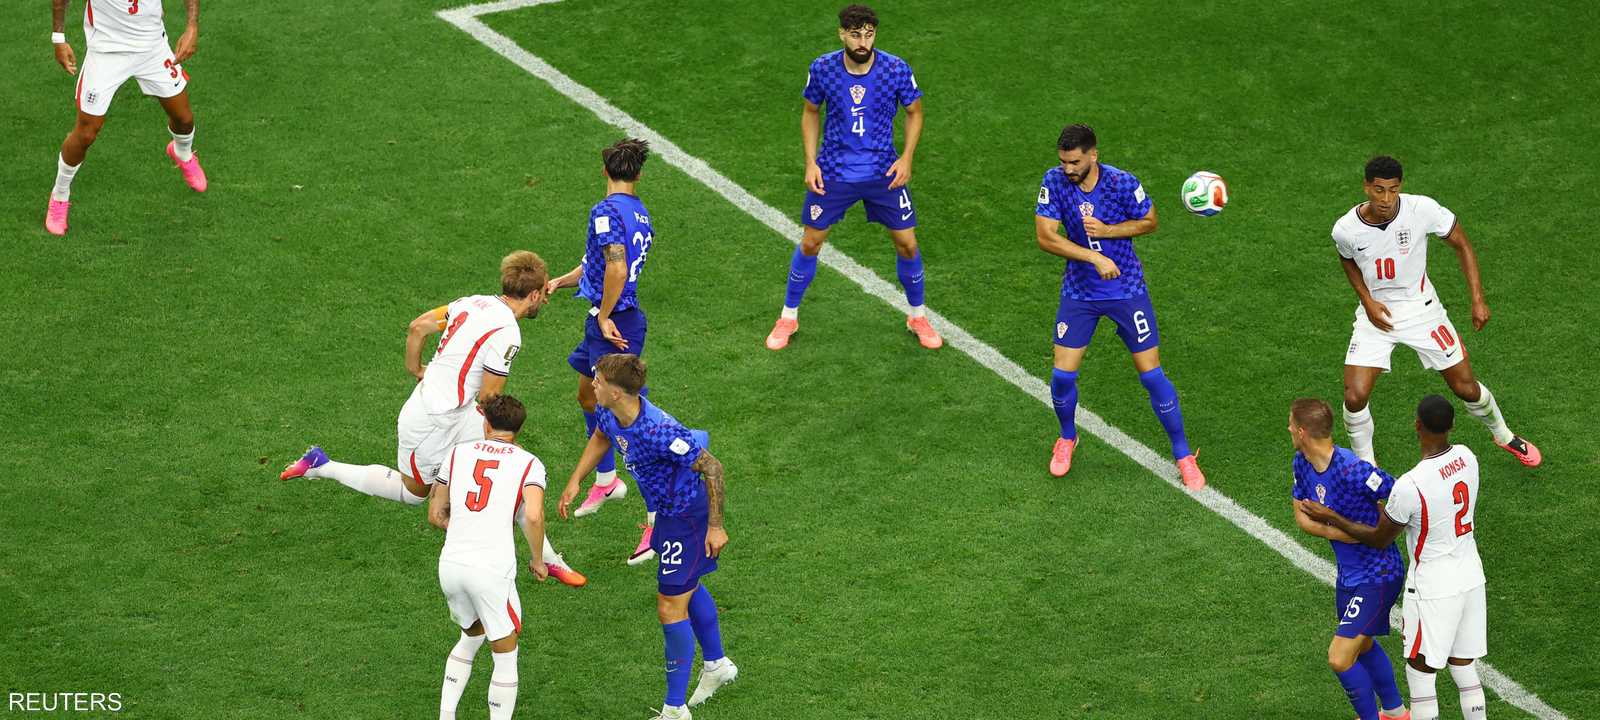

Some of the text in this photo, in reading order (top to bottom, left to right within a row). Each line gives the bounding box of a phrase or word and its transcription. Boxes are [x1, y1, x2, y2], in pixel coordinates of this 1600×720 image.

[163, 58, 178, 79] 3
[851, 116, 866, 137] 4
[899, 189, 912, 211] 4
[1375, 257, 1396, 280] 10
[1133, 310, 1151, 335] 6
[1431, 324, 1455, 351] 10
[474, 442, 515, 455] STONES
[1438, 456, 1467, 480] KONSA
[465, 459, 499, 512] 5
[1452, 480, 1473, 538] 2
[661, 541, 683, 565] 22
